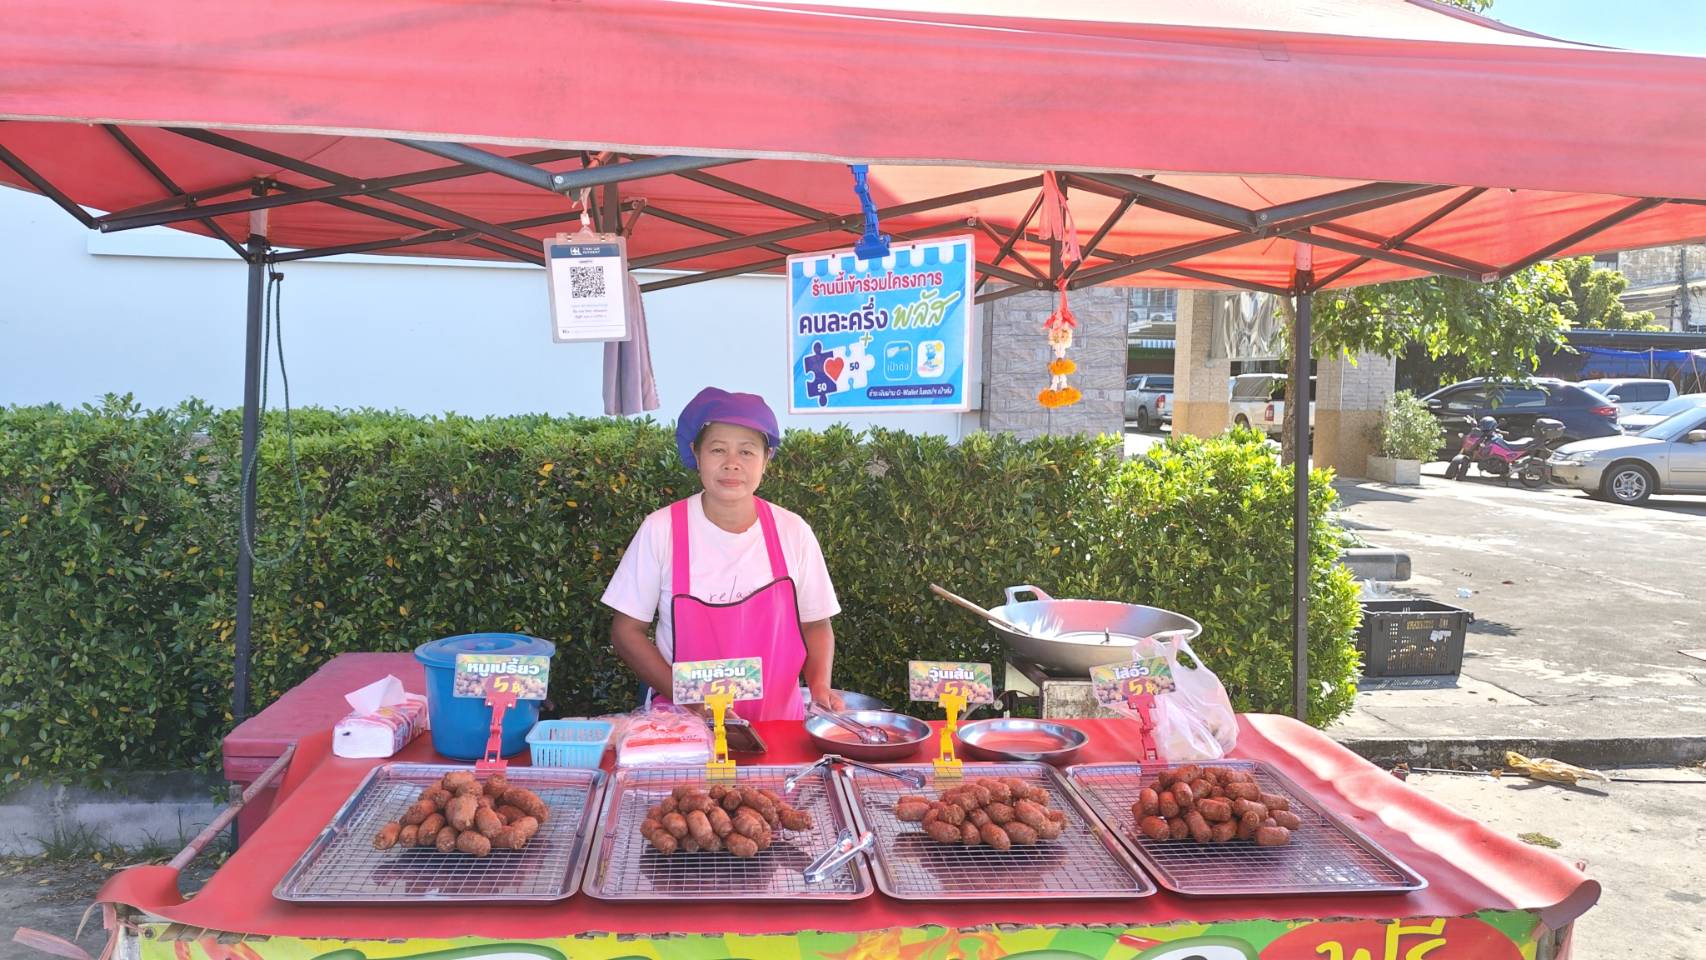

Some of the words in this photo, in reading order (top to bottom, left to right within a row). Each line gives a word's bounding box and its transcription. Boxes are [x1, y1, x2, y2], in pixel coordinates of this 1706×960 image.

[812, 271, 942, 297] ร้านนี้เข้าร่วมโครงการ
[799, 297, 888, 334] คนละครึ่ง
[893, 289, 960, 328] พลัส
[849, 361, 860, 372] 50
[817, 383, 827, 392] 50
[709, 576, 752, 603] rela
[466, 657, 540, 677] หมูเปรี้ยว
[691, 663, 746, 682] หมูล้วน
